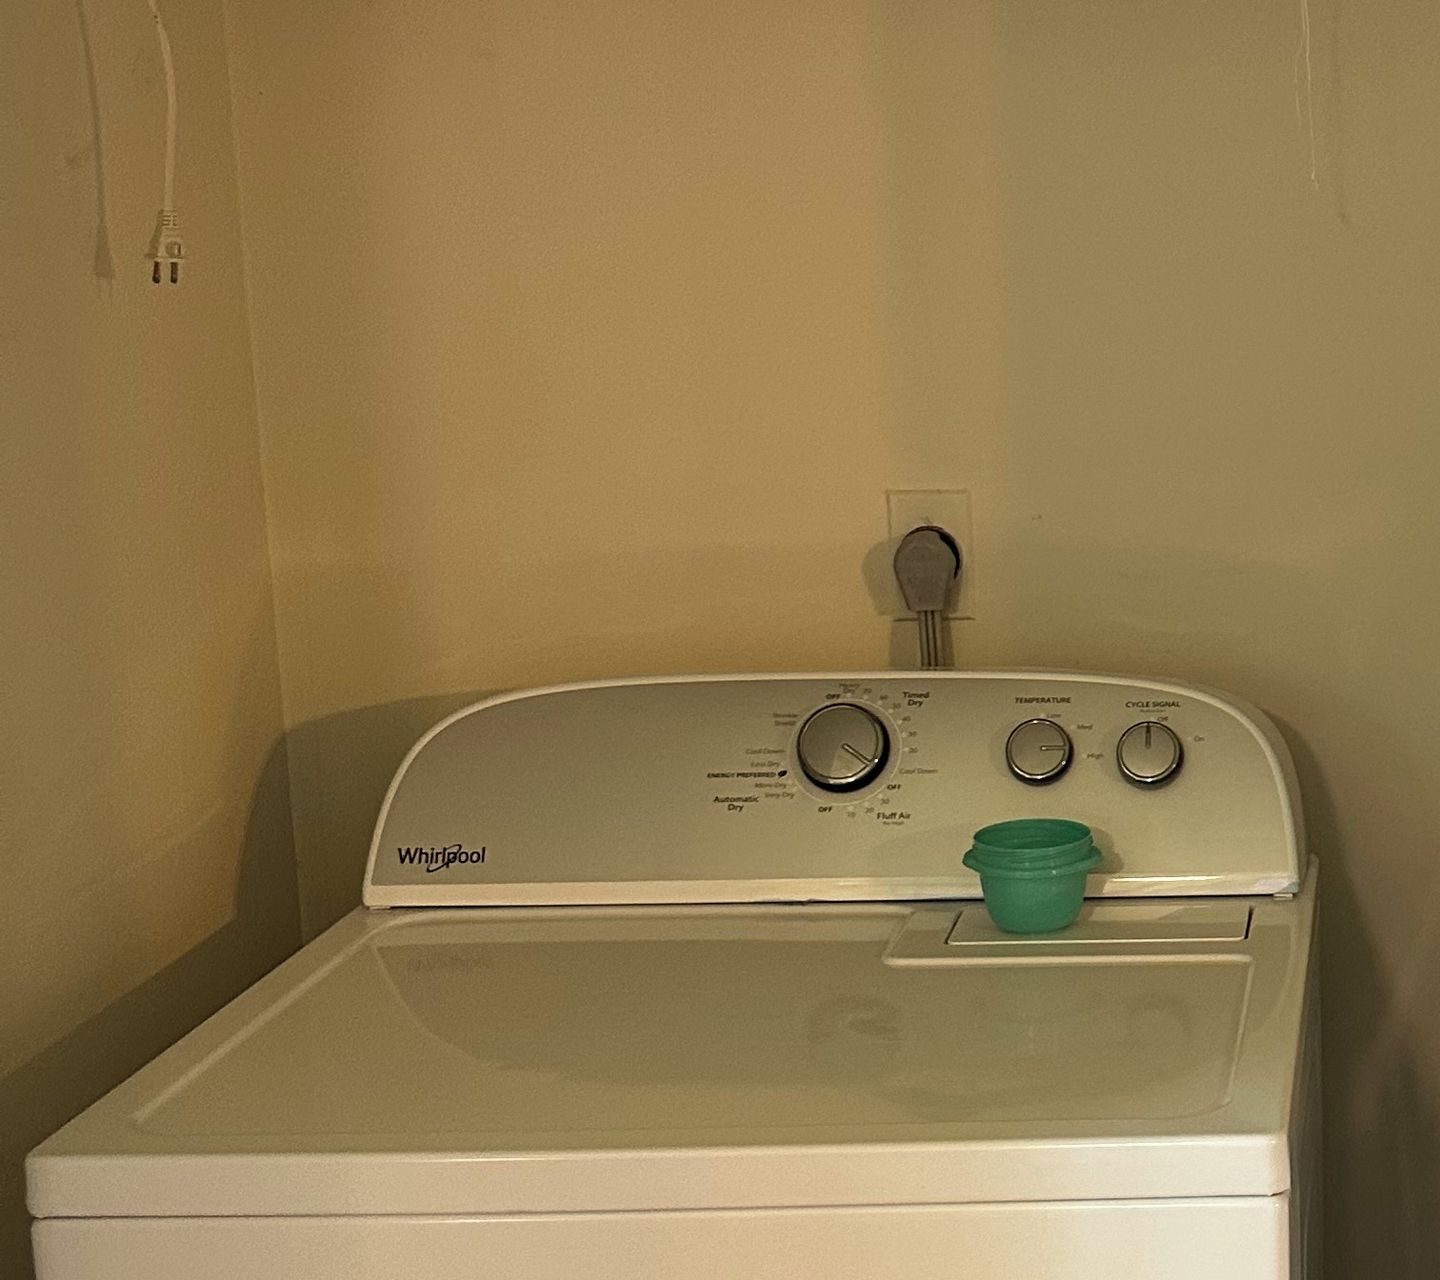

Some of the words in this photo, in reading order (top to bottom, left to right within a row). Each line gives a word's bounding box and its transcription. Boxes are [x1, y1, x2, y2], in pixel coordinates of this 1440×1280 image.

[902, 691, 930, 699] Timed
[907, 699, 924, 707] Dry
[1014, 696, 1071, 704] TEMPERATURE
[1152, 700, 1181, 708] SIGNAL
[713, 795, 760, 803] Automatic
[727, 803, 744, 812] Dry
[876, 812, 897, 820] Fluff
[397, 844, 487, 872] Whirlpool
